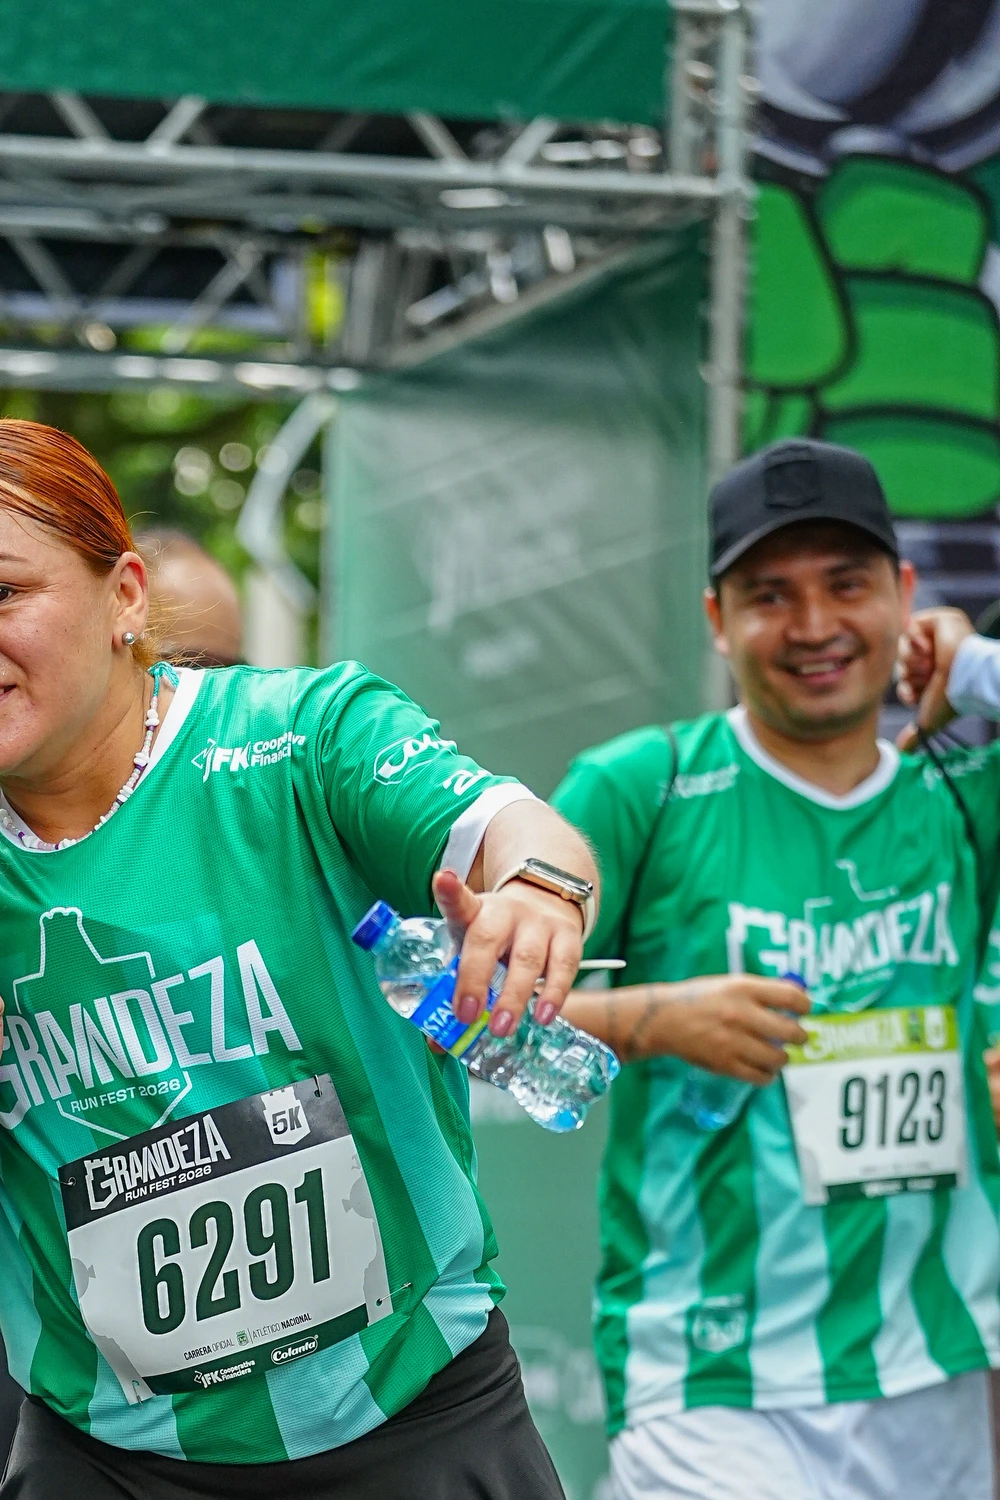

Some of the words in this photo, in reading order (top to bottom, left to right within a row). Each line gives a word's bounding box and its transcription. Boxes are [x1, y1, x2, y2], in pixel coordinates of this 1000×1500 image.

[203, 741, 251, 783] JFK
[251, 742, 291, 767] Financi
[71, 1096, 98, 1113] RUN
[100, 1087, 136, 1107] FEST
[139, 1079, 181, 1097] 2026
[841, 1069, 946, 1149] 9123
[271, 1105, 302, 1136] 5K
[84, 1114, 231, 1211] GRANDEZA
[125, 1187, 148, 1202] RUN
[149, 1178, 177, 1194] FEST
[178, 1165, 213, 1184] 2026
[136, 1167, 331, 1335] 6291
[183, 1345, 213, 1361] CARRERA
[212, 1339, 235, 1353] OFICIAL
[252, 1322, 281, 1339] ATLÉTICO
[281, 1312, 312, 1329] NACIONAL
[272, 1340, 316, 1362] Colanta
[201, 1370, 223, 1388] JFK
[220, 1359, 256, 1375] Cooperativa
[221, 1368, 252, 1382] Financiera
